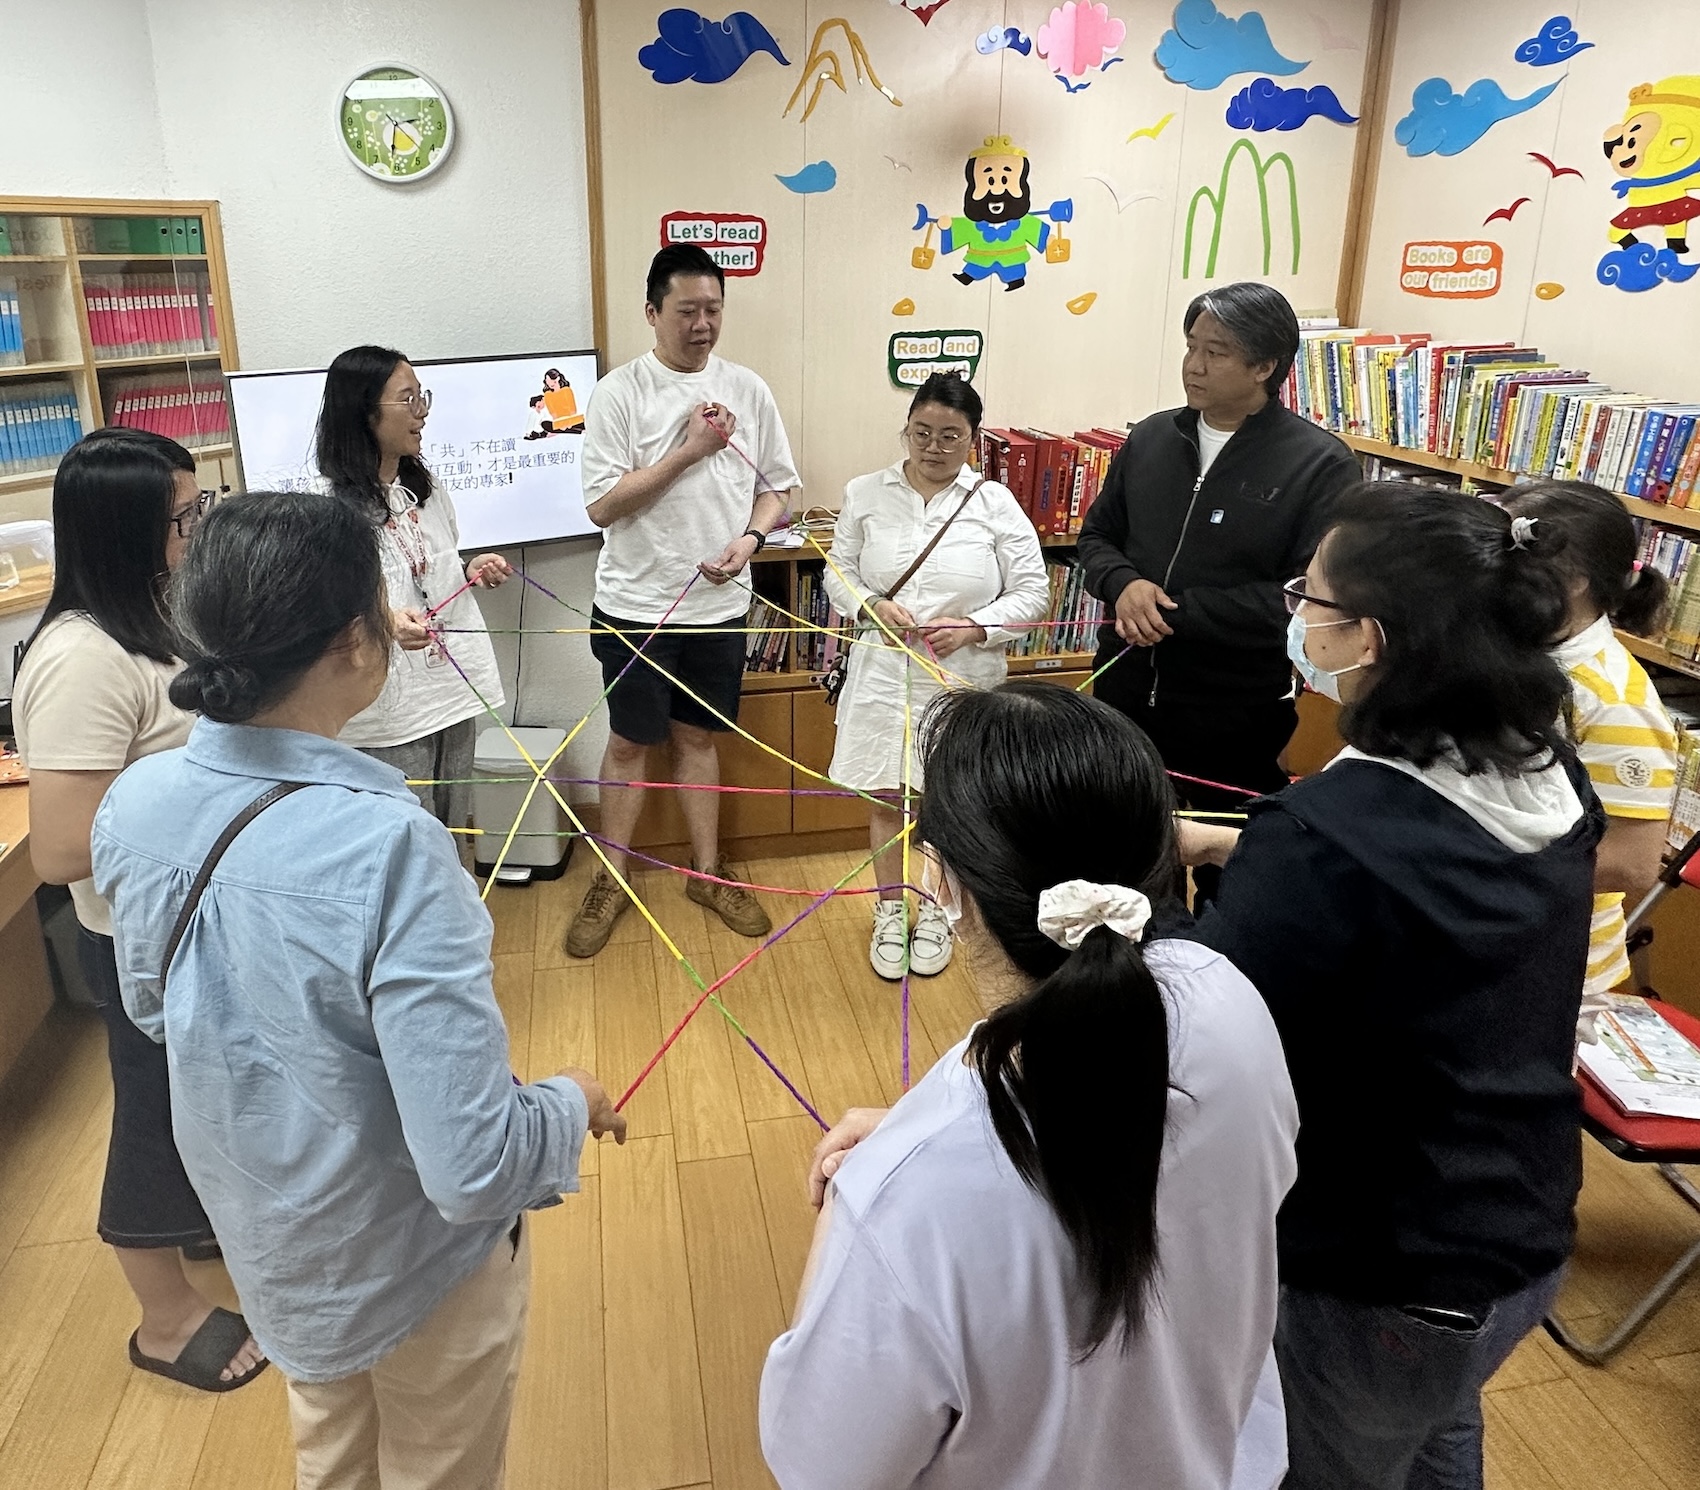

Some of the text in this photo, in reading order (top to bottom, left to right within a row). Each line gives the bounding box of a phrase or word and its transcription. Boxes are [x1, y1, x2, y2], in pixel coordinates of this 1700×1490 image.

[429, 99, 434, 107] 2
[347, 117, 353, 125] 9
[437, 122, 442, 130] 3
[356, 141, 362, 149] 8
[430, 144, 435, 152] 4
[373, 155, 378, 163] 7
[415, 157, 421, 165] 5
[671, 224, 759, 240] Let's read
[709, 251, 754, 265] ther!
[1409, 248, 1490, 264] Books are
[1404, 271, 1494, 289] our friends!
[897, 339, 976, 354] Read and
[1564, 416, 1573, 439] TRACTOR
[1627, 428, 1636, 447] YOGA
